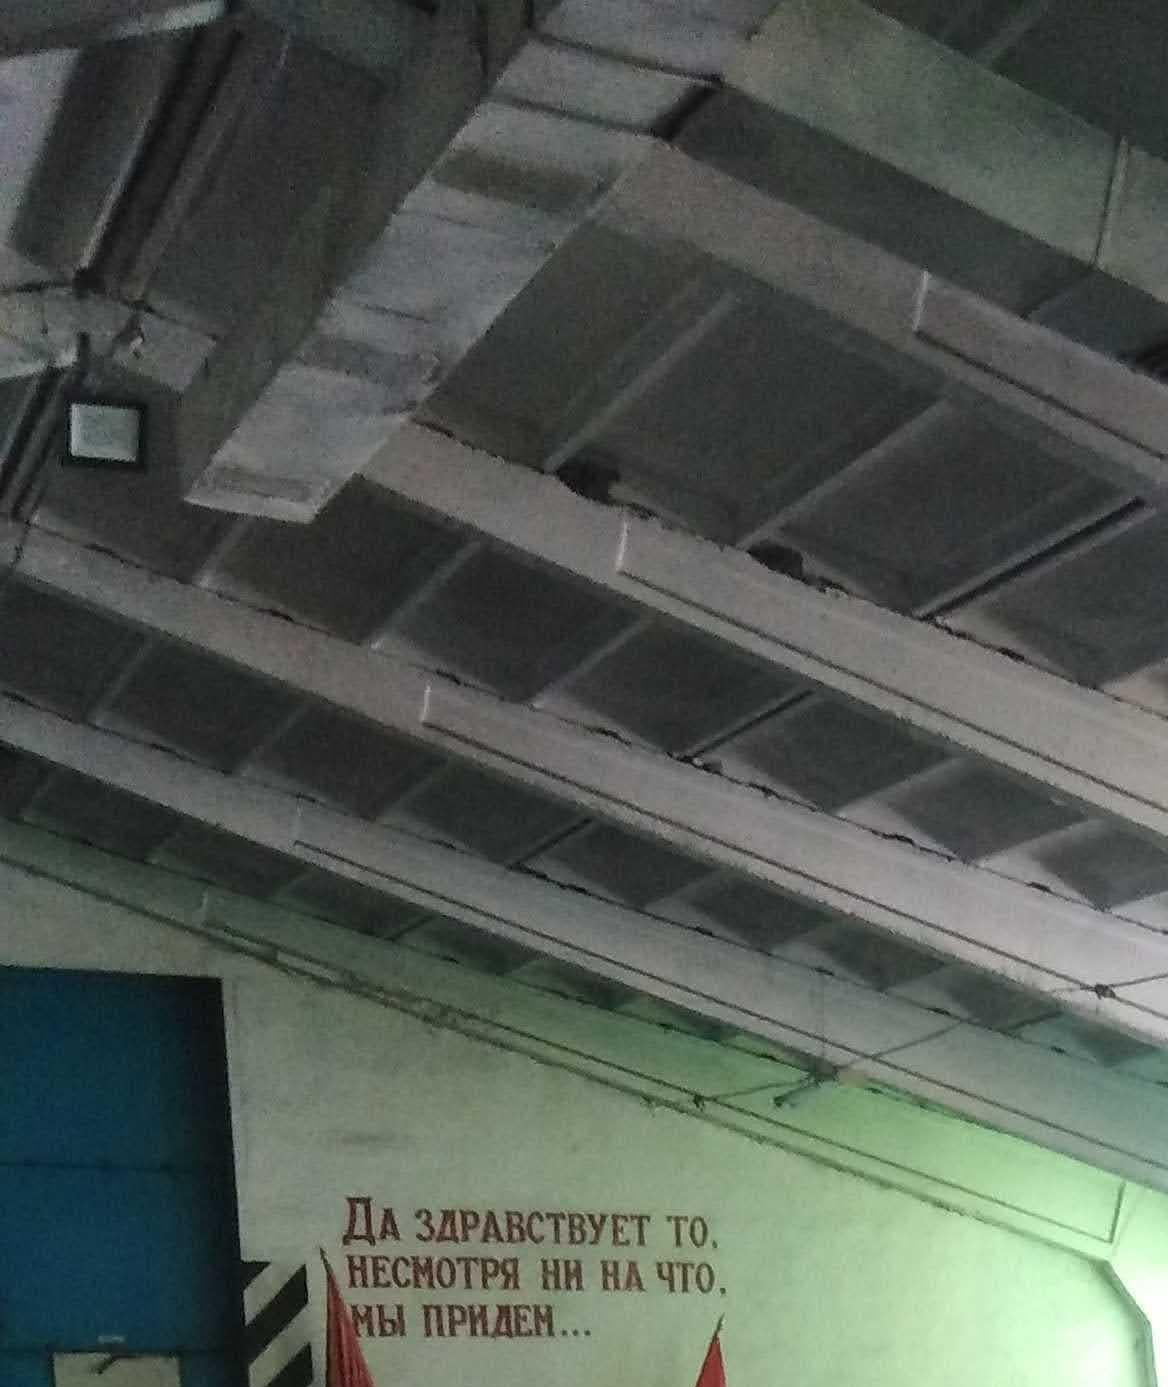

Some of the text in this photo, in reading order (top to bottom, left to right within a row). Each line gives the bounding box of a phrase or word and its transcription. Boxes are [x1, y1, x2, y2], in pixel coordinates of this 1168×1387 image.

[414, 1208, 651, 1247] ЗДРАВСТВУЕТ
[346, 1254, 521, 1290] НЕСМОТРЯ
[541, 1258, 584, 1292] НИ
[601, 1260, 646, 1293] НА
[351, 1304, 406, 1338] МЫ
